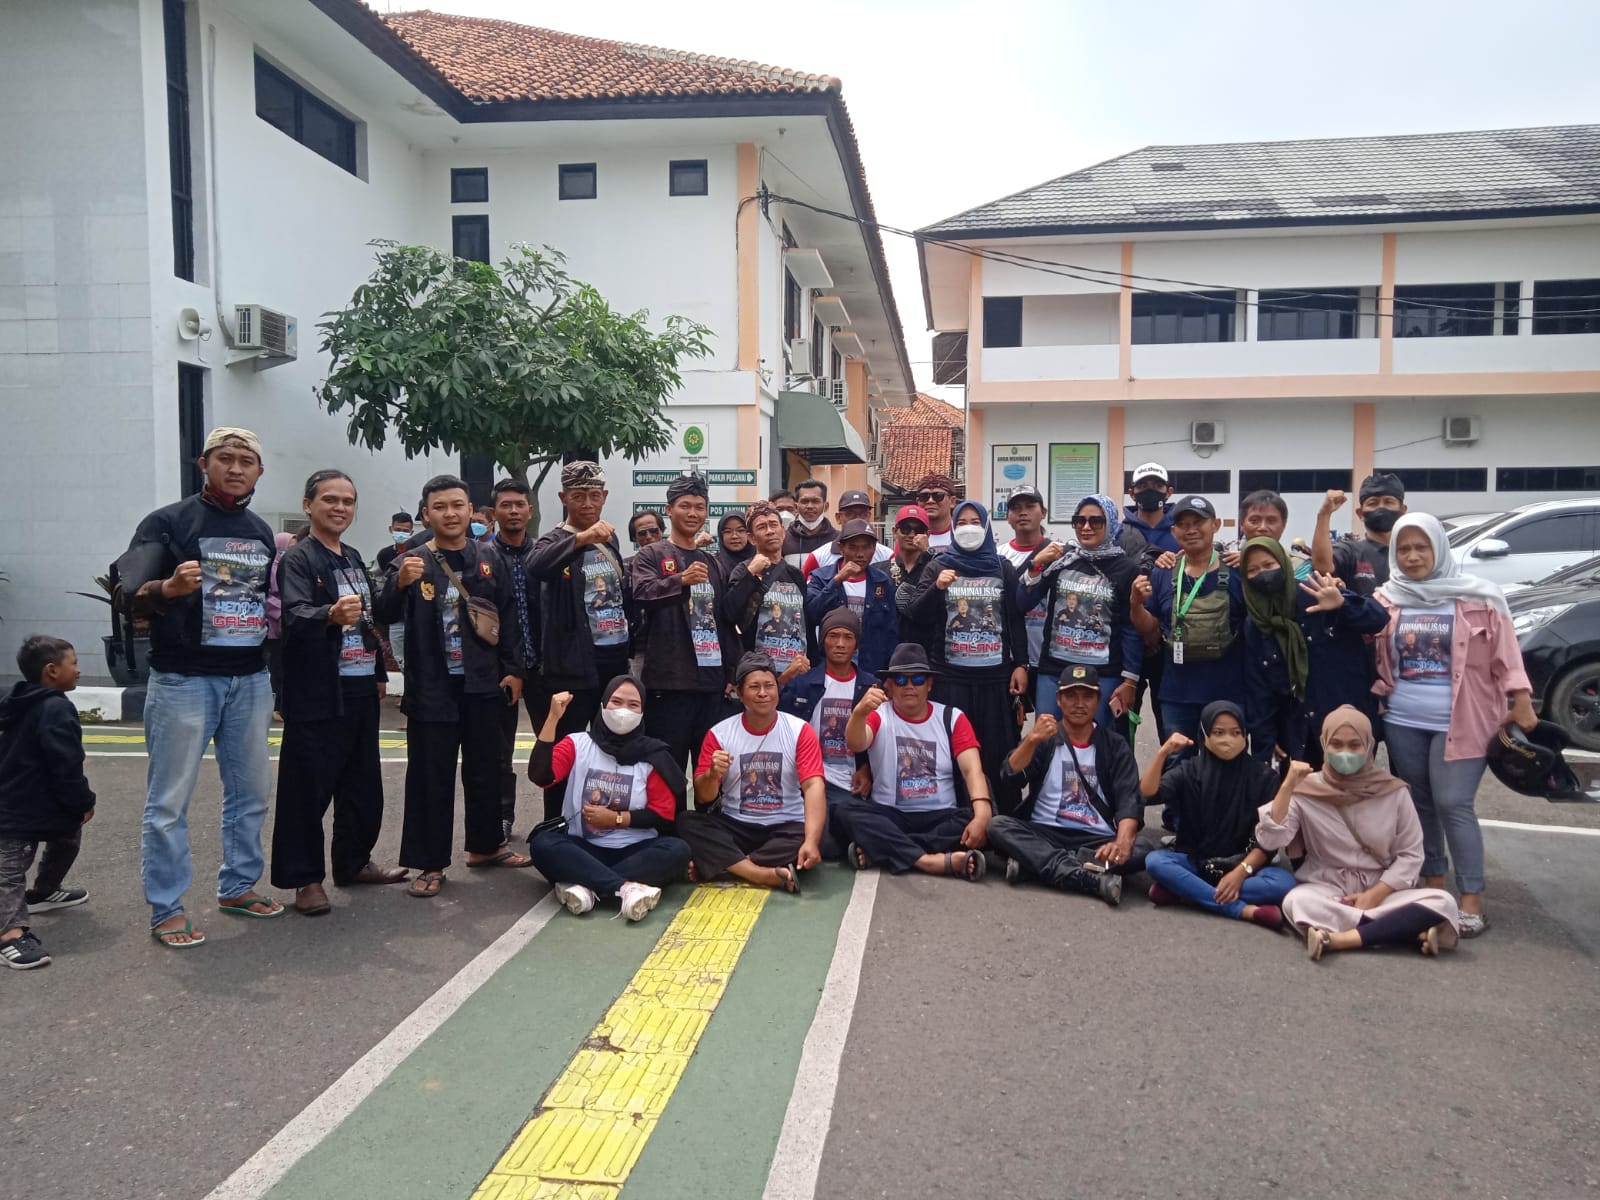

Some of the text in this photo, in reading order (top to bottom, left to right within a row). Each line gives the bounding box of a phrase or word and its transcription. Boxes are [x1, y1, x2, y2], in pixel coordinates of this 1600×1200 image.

[725, 474, 747, 482] PEGAWAI
[710, 506, 722, 515] POS
[213, 615, 268, 628] GALAN
